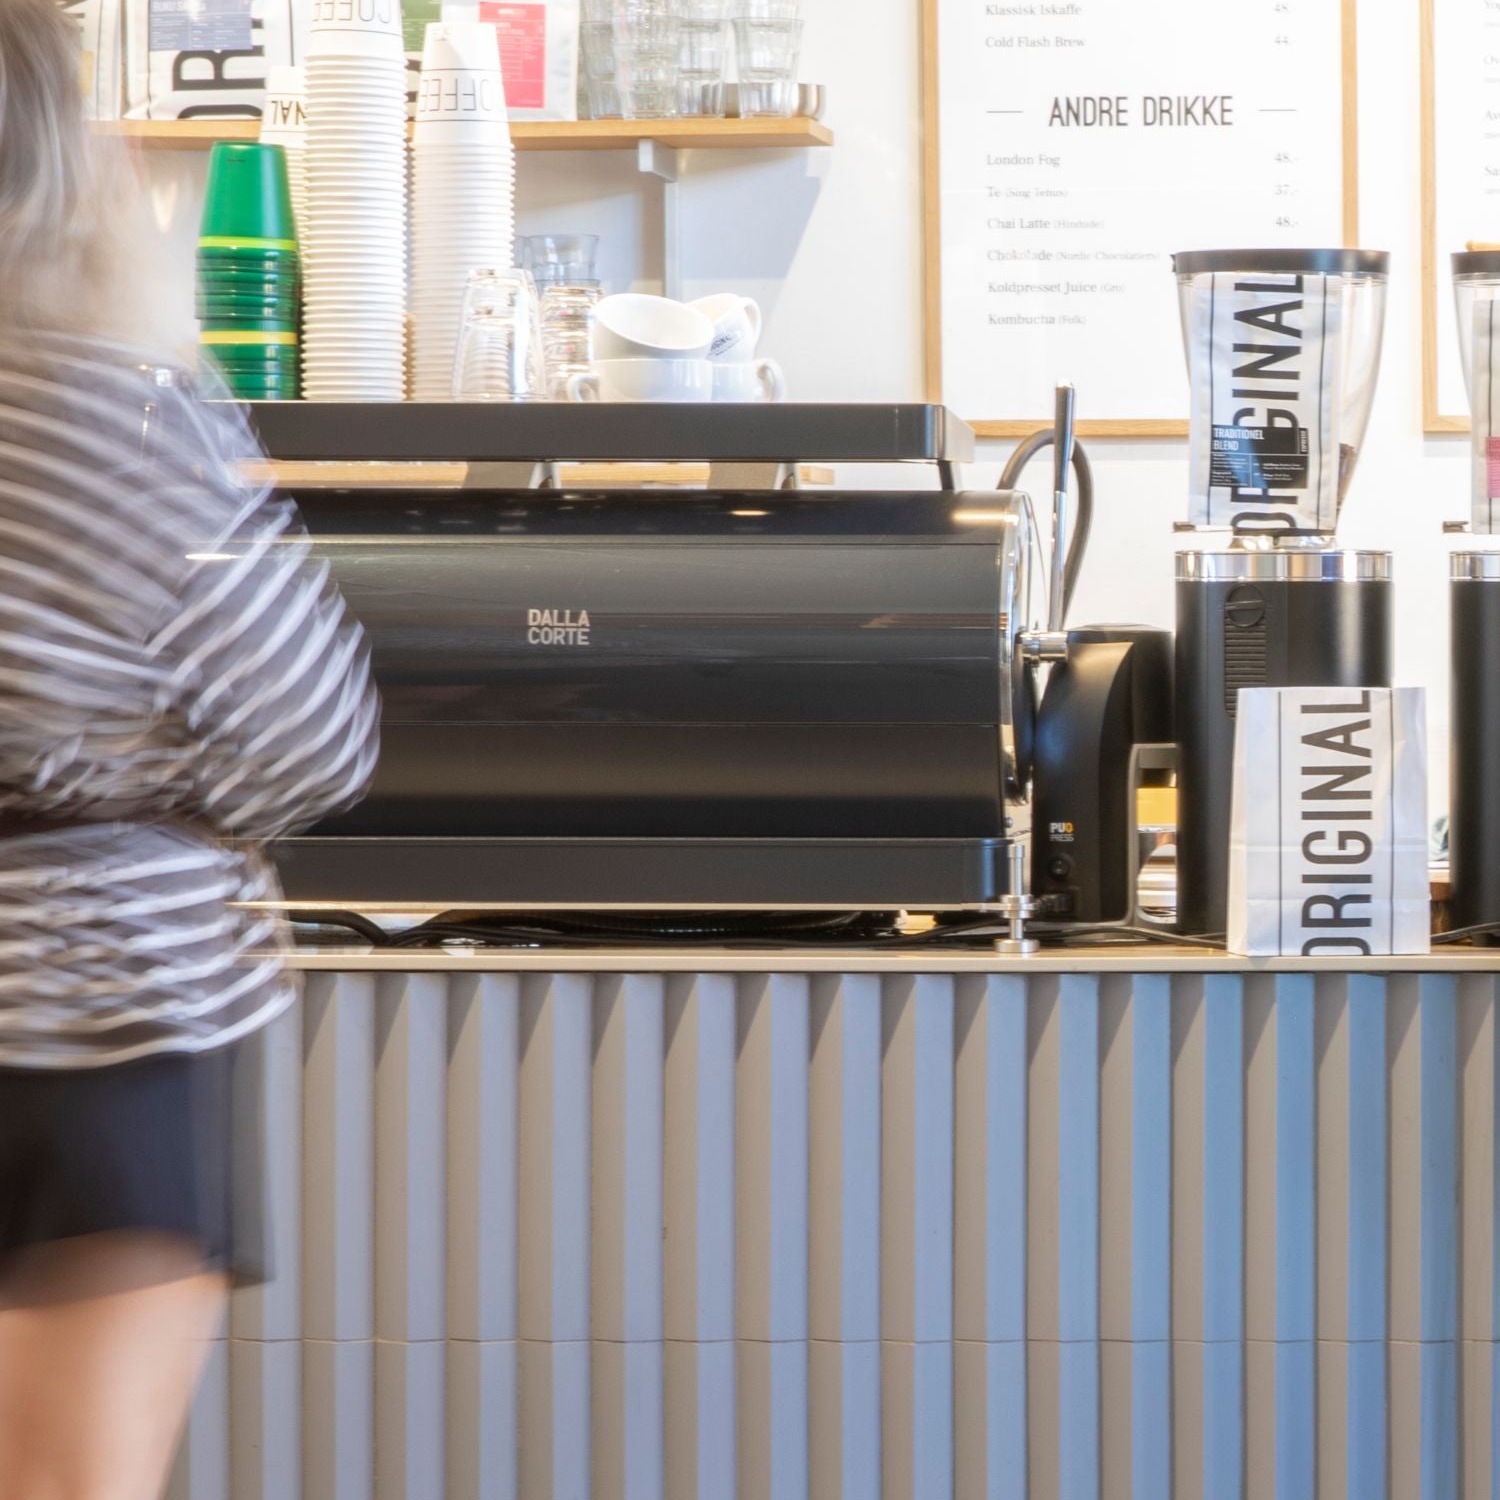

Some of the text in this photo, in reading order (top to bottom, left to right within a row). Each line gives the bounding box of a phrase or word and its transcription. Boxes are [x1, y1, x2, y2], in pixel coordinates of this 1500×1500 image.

[985, 4, 1036, 16] Klassisk
[985, 36, 1085, 48] Cold Flash Brew
[1048, 96, 1234, 127] ANDRE DRIKKE
[986, 154, 1034, 165] London
[1038, 154, 1061, 167] Fog
[986, 186, 1002, 197] Te
[987, 218, 1016, 229] Chai
[1020, 218, 1051, 229] Latte
[1274, 216, 1299, 228] 48.-
[988, 282, 1061, 295] Koldpresset
[1064, 282, 1097, 295] Juice
[988, 314, 1055, 325] Kombucha
[1212, 428, 1265, 440] TRADITIONEL
[1212, 440, 1239, 451] BLEND
[528, 609, 591, 626] DALLA
[528, 627, 591, 645] CORTE
